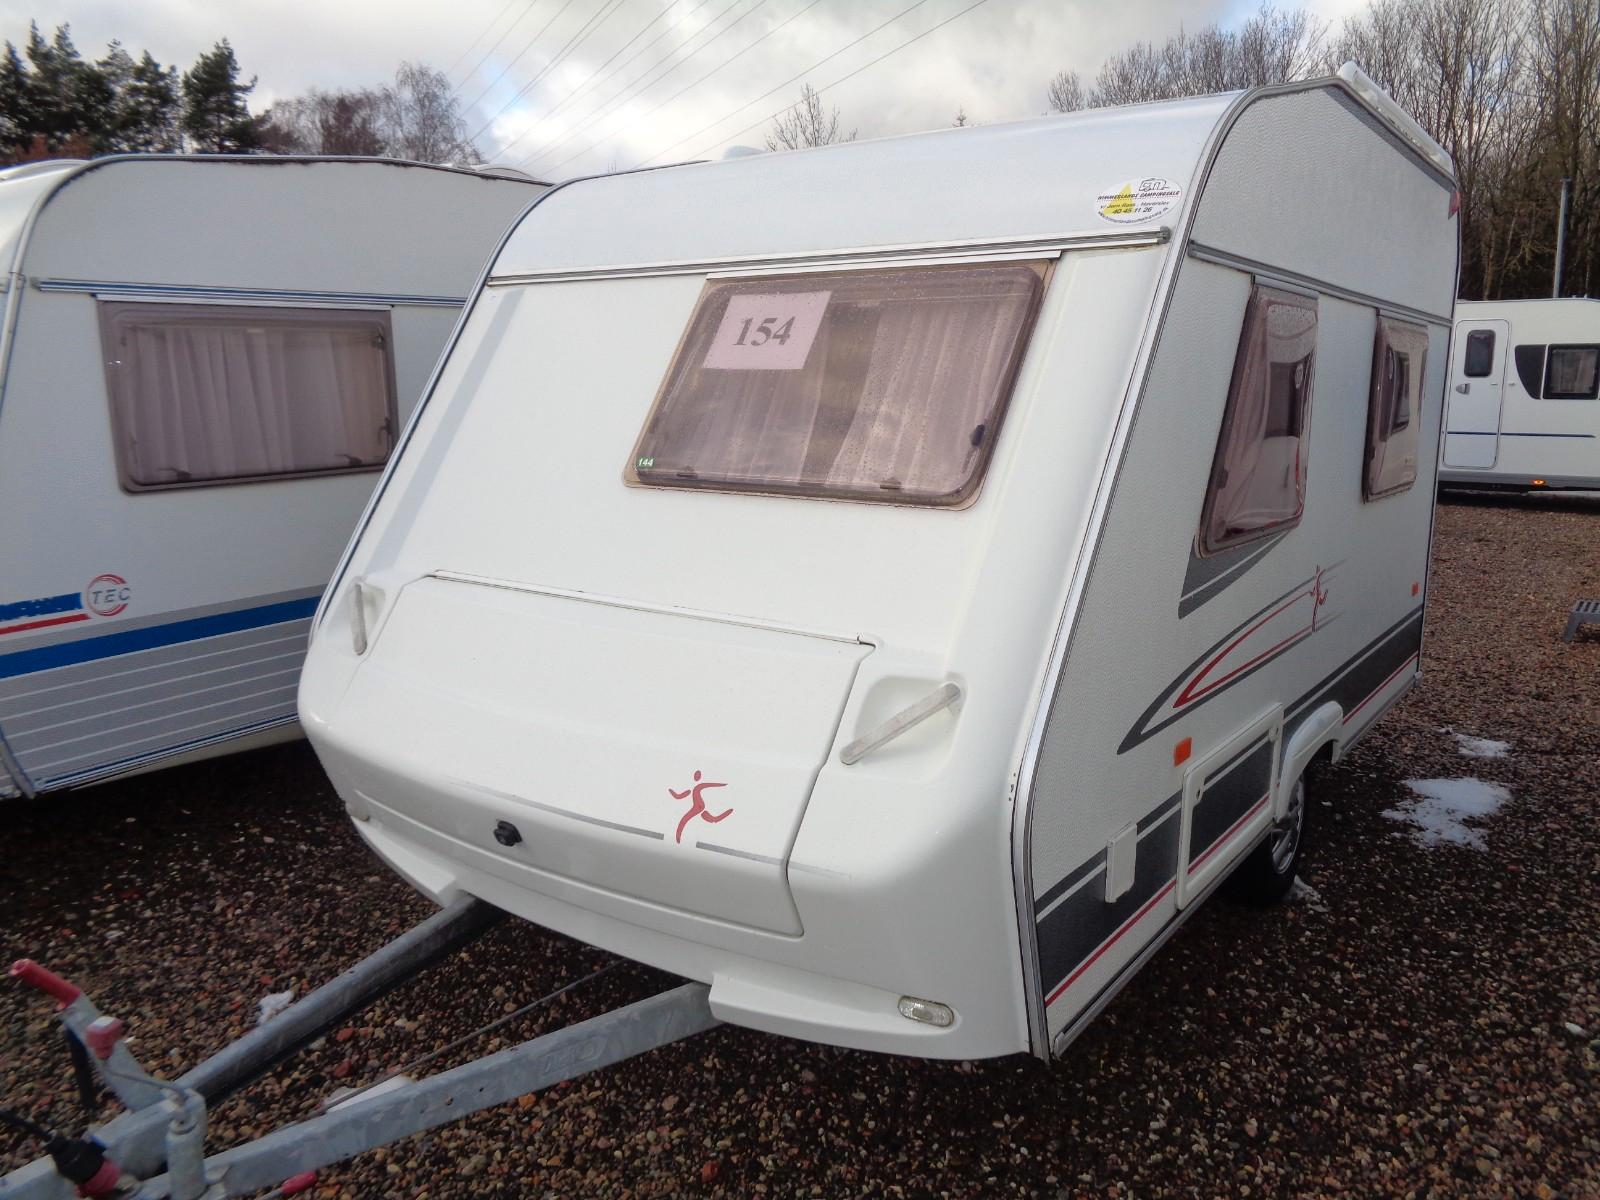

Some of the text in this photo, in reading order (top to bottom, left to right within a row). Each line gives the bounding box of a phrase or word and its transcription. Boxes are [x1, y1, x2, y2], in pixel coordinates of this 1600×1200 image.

[732, 316, 796, 346] 154
[639, 458, 654, 468] 144
[92, 587, 131, 605] TEC
